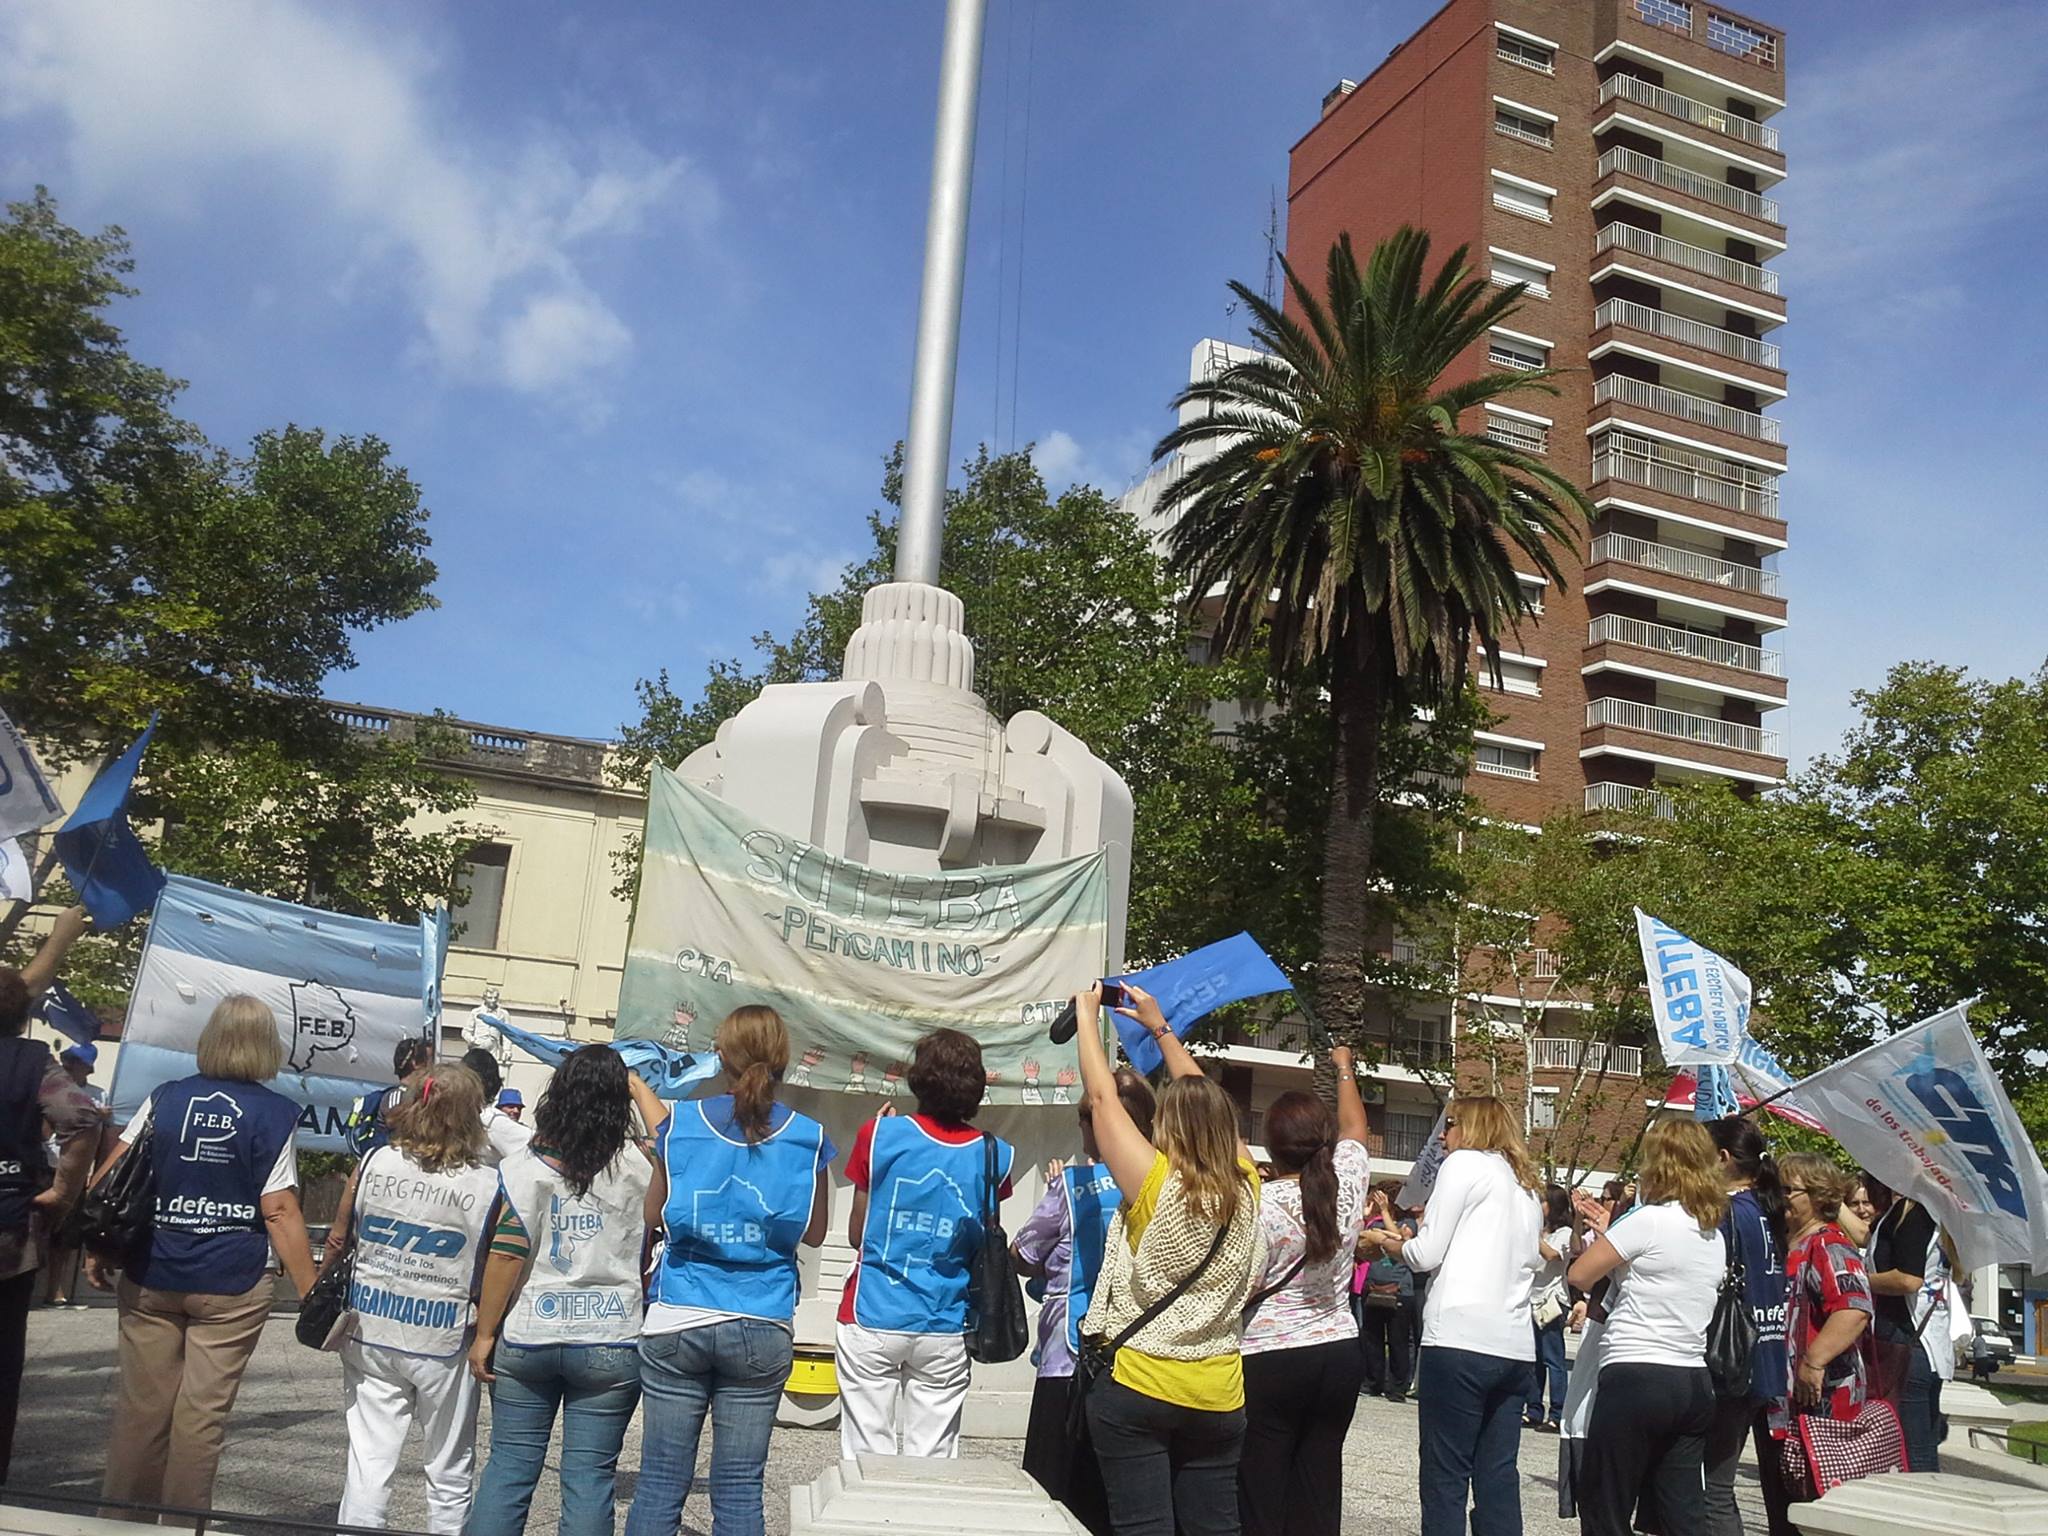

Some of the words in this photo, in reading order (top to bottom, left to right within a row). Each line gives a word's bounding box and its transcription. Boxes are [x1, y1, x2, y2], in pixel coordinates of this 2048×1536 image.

[740, 830, 1024, 932] SUTEBA
[676, 949, 733, 985] CTA
[299, 1016, 348, 1038] F.E.B.
[193, 1112, 236, 1131] F.E.B.
[1866, 1098, 1882, 1113] de
[1880, 1111, 1901, 1131] los
[365, 1172, 476, 1212] PERGAMINO
[168, 1195, 256, 1220] defensa
[550, 1213, 604, 1231] SUTEBA
[701, 1223, 764, 1244] F.E.B.
[895, 1210, 956, 1238] F.E.B.
[360, 1214, 467, 1260] CTA
[403, 1256, 418, 1267] de
[419, 1258, 435, 1270] los
[402, 1269, 460, 1287] argentinos
[535, 1291, 628, 1321] CTERA
